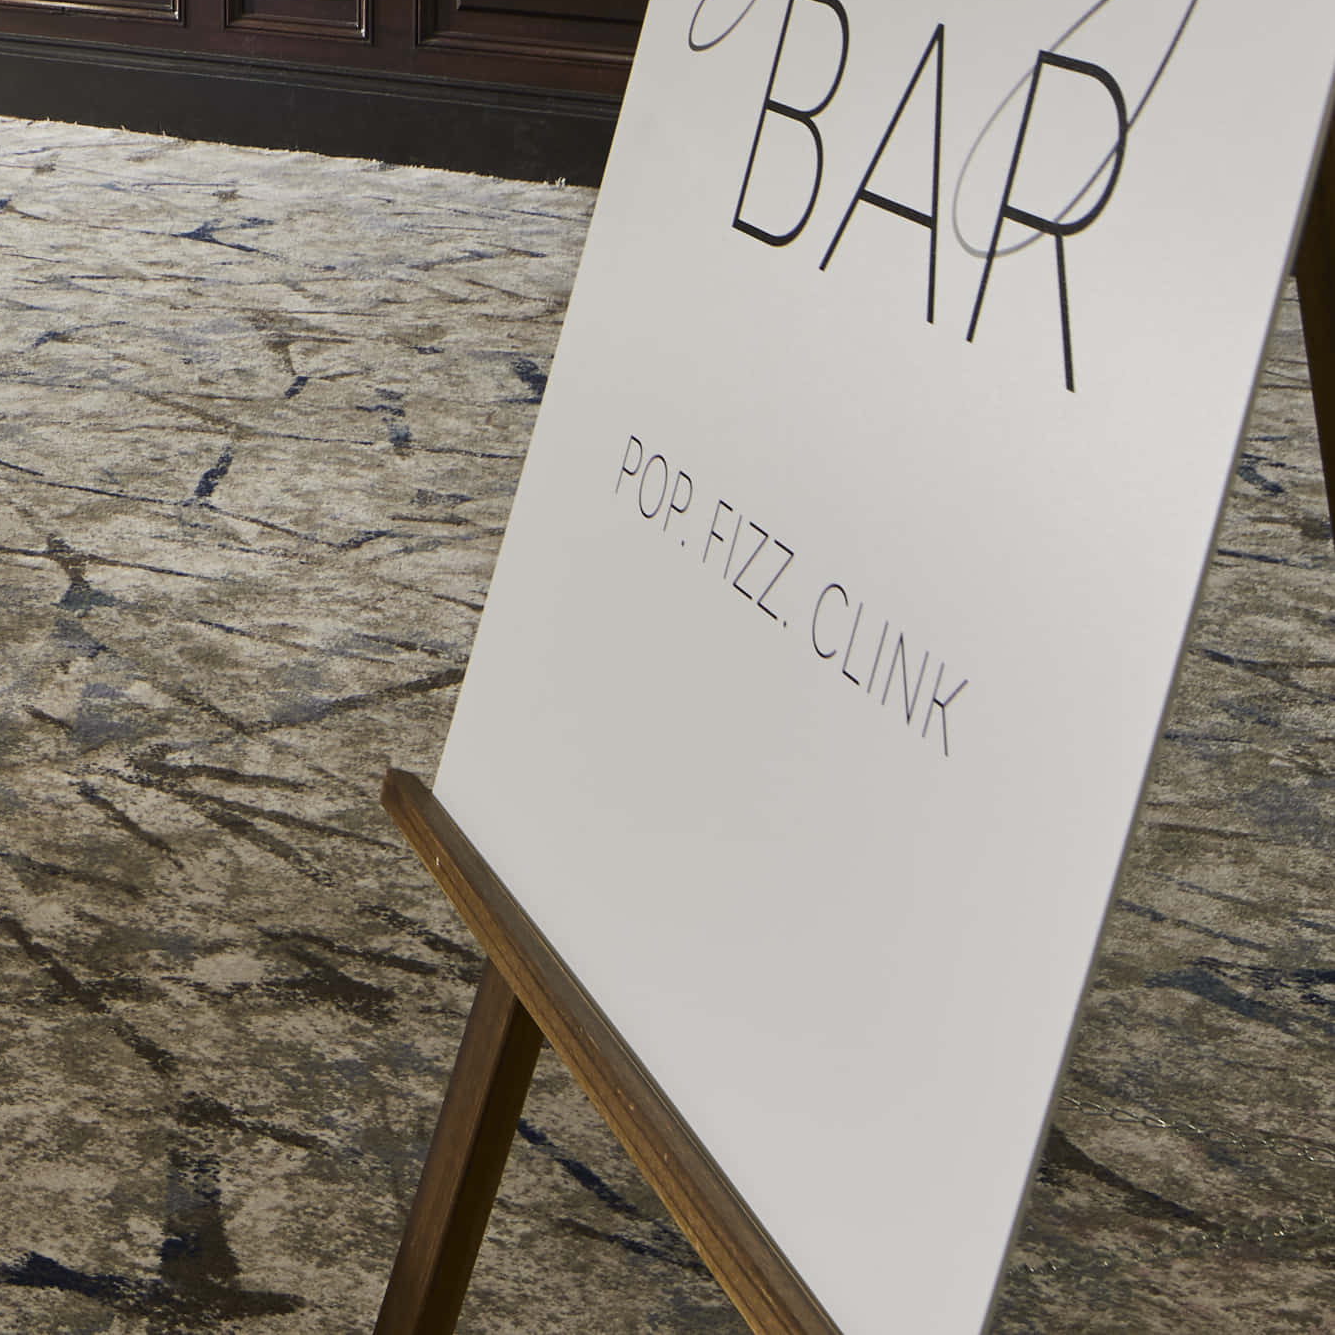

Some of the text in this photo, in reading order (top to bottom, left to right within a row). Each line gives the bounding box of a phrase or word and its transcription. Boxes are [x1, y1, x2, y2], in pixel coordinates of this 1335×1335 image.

[615, 434, 969, 757] POP. FIZZ. CLINK
